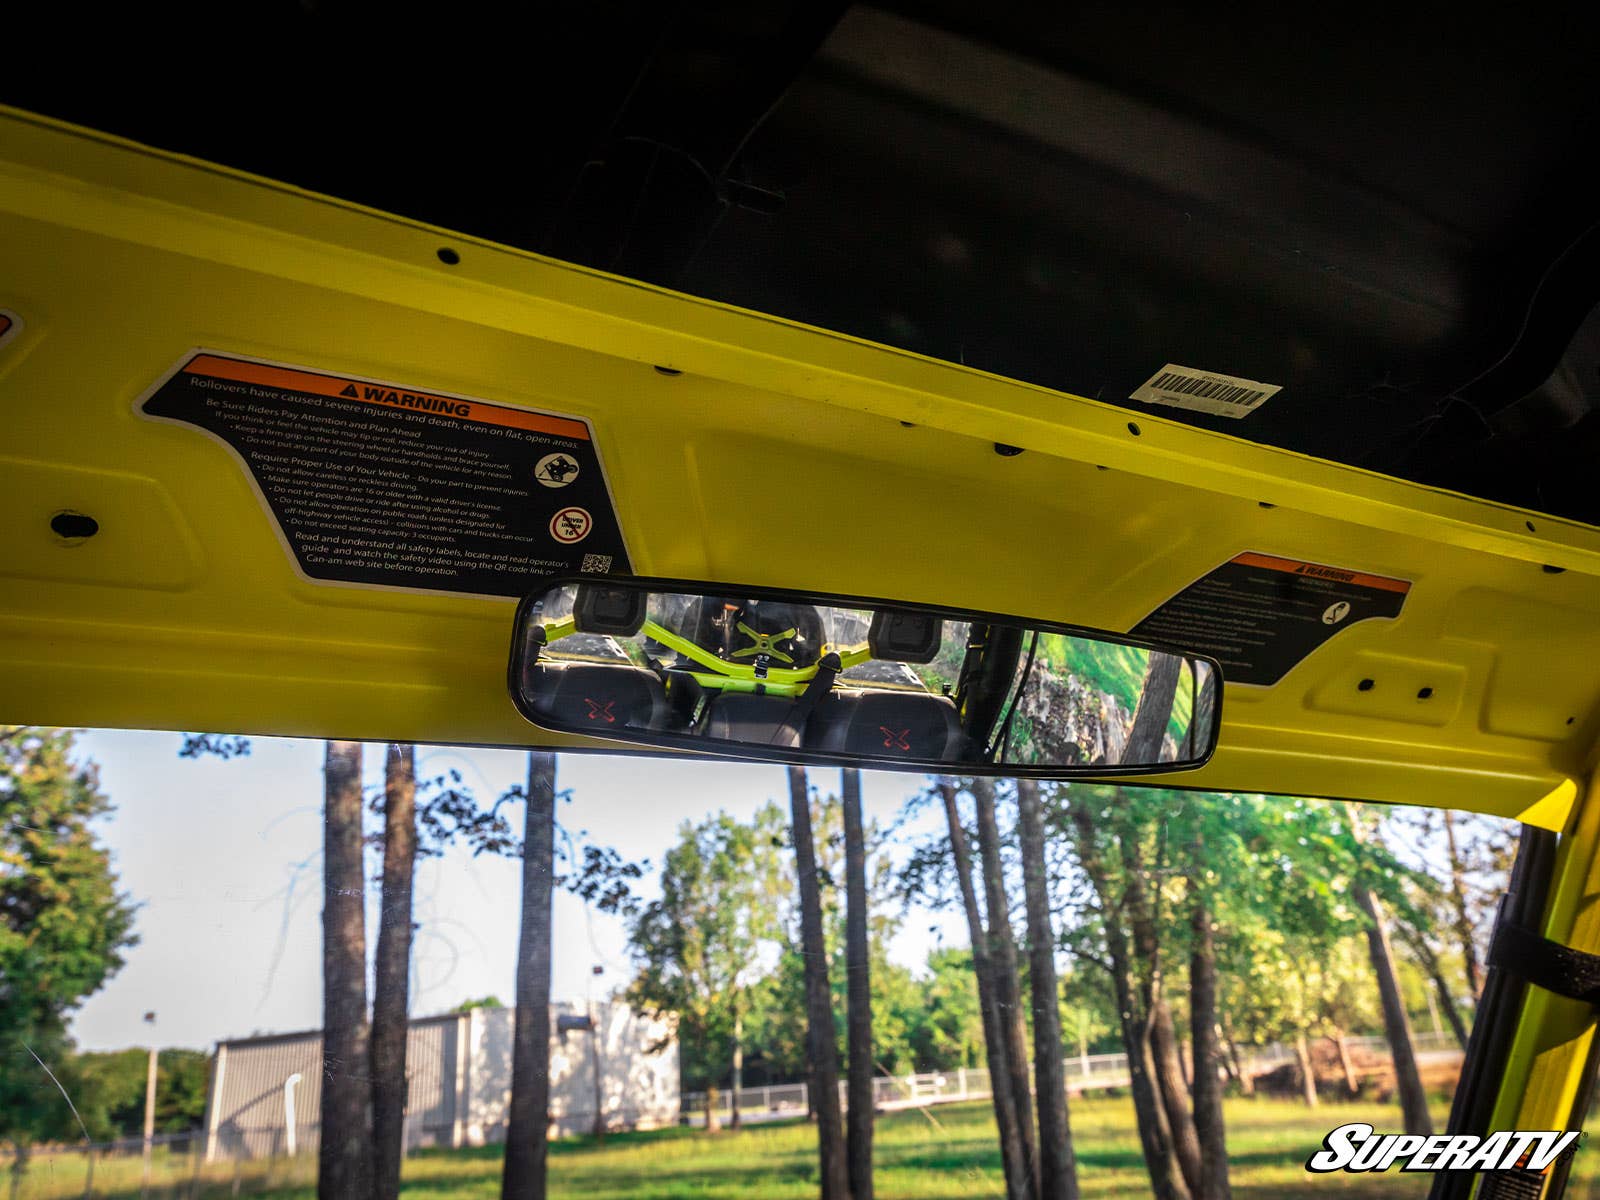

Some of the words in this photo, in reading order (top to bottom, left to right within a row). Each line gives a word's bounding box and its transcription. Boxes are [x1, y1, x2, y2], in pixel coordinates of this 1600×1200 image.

[190, 376, 246, 395] Rollovers
[248, 386, 278, 400] have
[280, 391, 322, 407] caused
[325, 401, 360, 413] severe
[362, 404, 402, 421] injuries
[405, 412, 425, 424] and
[428, 416, 460, 431] death,
[463, 424, 486, 434] even
[489, 428, 502, 436] on
[505, 428, 523, 441] flat,
[525, 434, 550, 445] open
[363, 386, 470, 416] WARNING
[206, 398, 221, 407] Be
[222, 400, 245, 411] Sure
[247, 404, 279, 416] Riders
[281, 409, 299, 421] Pay
[301, 412, 347, 427] Attention
[348, 420, 366, 430] and
[369, 423, 386, 433] Plan
[387, 426, 421, 438] Ahead
[251, 451, 290, 465] Require
[291, 456, 323, 470] Proper
[325, 461, 342, 471] Use
[345, 464, 355, 472] of
[355, 465, 375, 475] Your
[378, 468, 409, 480] Vehicle
[418, 475, 429, 483] Do
[430, 478, 447, 487] your
[448, 480, 464, 489] part
[473, 483, 501, 494] prevent
[295, 531, 318, 541] Read
[321, 534, 339, 543] and
[341, 536, 394, 548] understand
[396, 541, 406, 550] all
[408, 543, 433, 554] safety
[436, 546, 462, 558] labels,
[464, 549, 490, 559] locate
[491, 552, 508, 561] and
[509, 554, 528, 563] read
[301, 542, 329, 554] guide
[333, 545, 352, 554] and
[353, 547, 381, 557] watch
[383, 550, 398, 559] the
[400, 552, 426, 564] safety
[428, 555, 452, 564] video
[453, 558, 476, 569] using
[479, 560, 492, 569] the
[494, 562, 506, 570] QR
[507, 563, 528, 572] code
[529, 565, 544, 574] link
[306, 553, 342, 564] Can-am
[344, 557, 365, 566] web
[366, 559, 382, 568] site
[384, 560, 413, 571] before
[1304, 565, 1355, 582] WARNING
